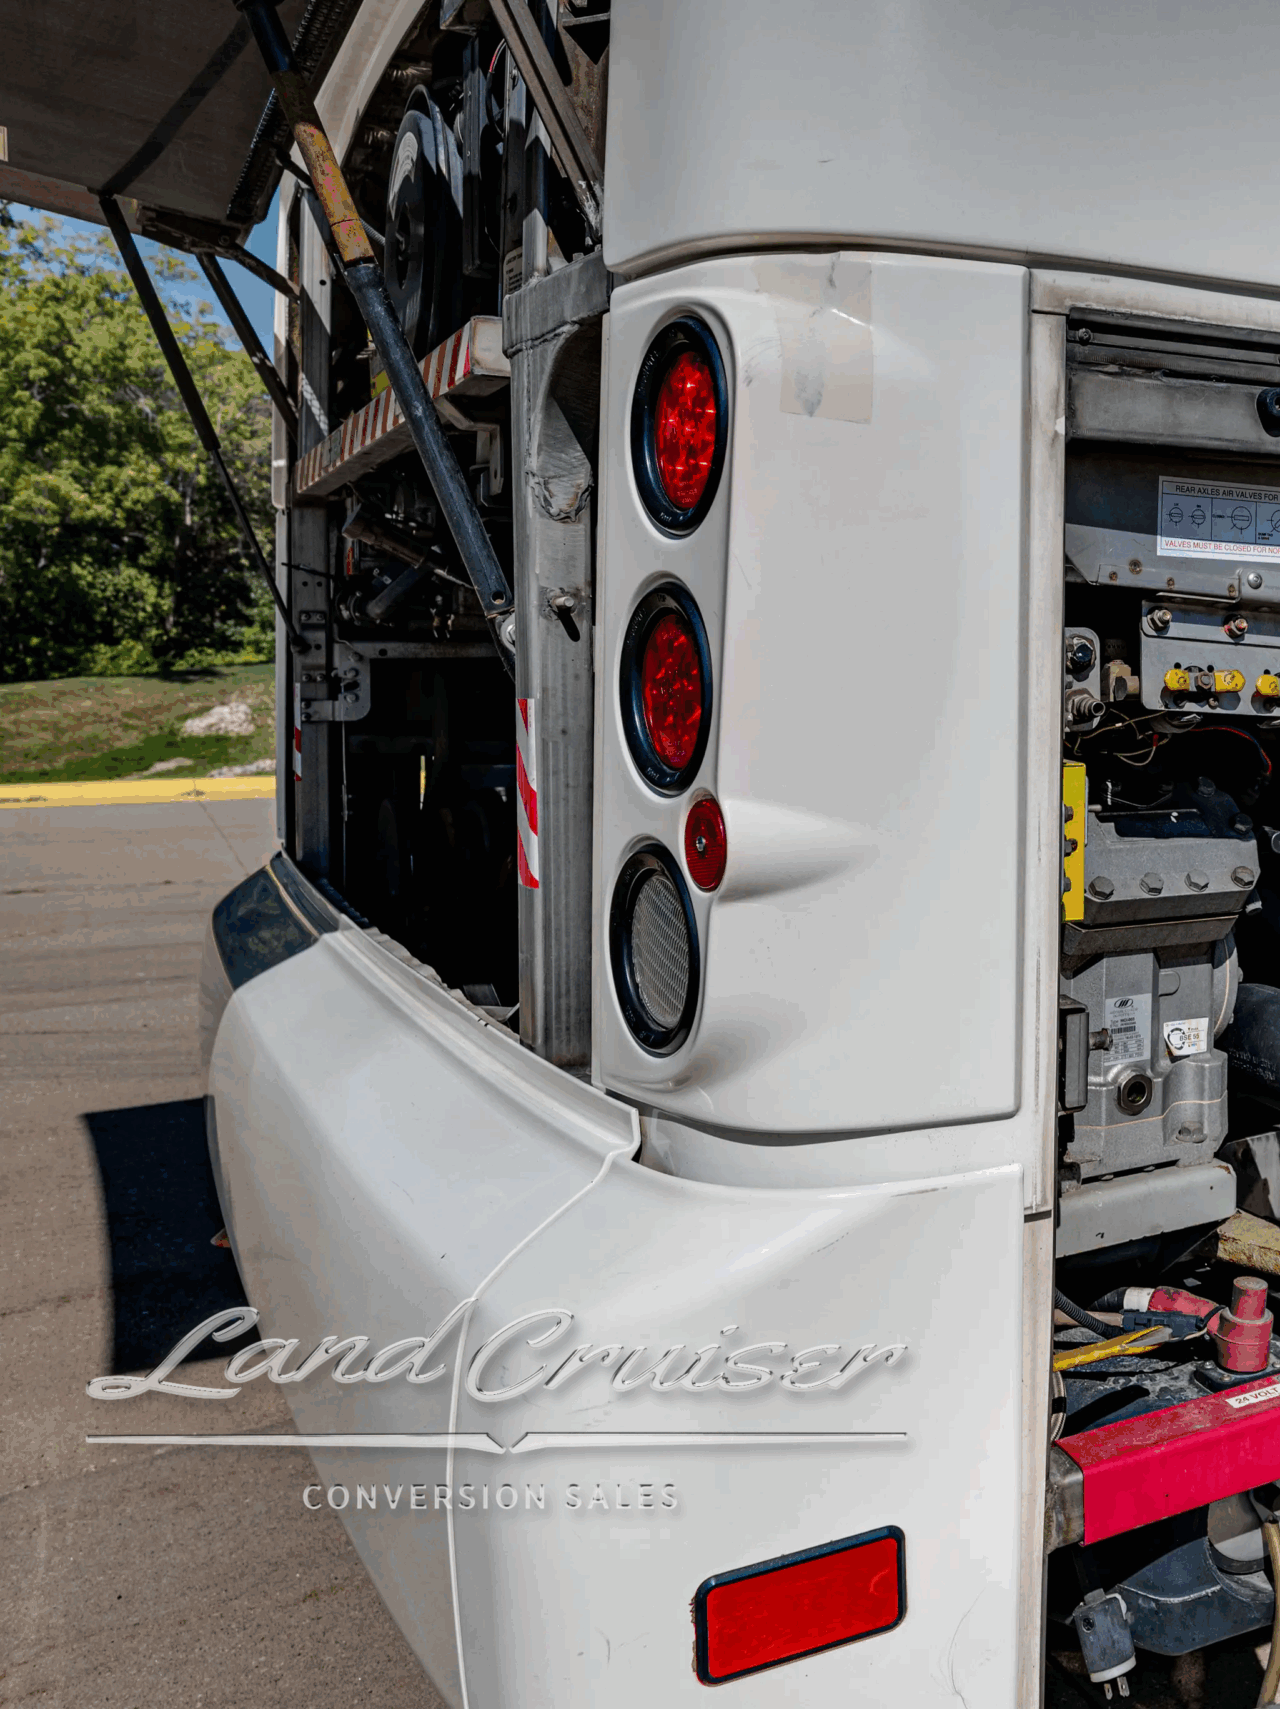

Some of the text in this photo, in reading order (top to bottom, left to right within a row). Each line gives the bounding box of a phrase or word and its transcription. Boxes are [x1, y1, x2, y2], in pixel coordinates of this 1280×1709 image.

[1176, 485, 1196, 494] REAR
[1197, 487, 1221, 496] AXLES
[1235, 491, 1263, 500] VALVES
[1264, 493, 1279, 501] FOR
[1164, 540, 1192, 549] VALVES
[1193, 542, 1212, 550] MUST
[1213, 543, 1223, 551] BE
[1224, 544, 1252, 553] CLOSED
[1252, 545, 1267, 554] FOR
[1235, 1387, 1279, 1404] 24 VOLT
